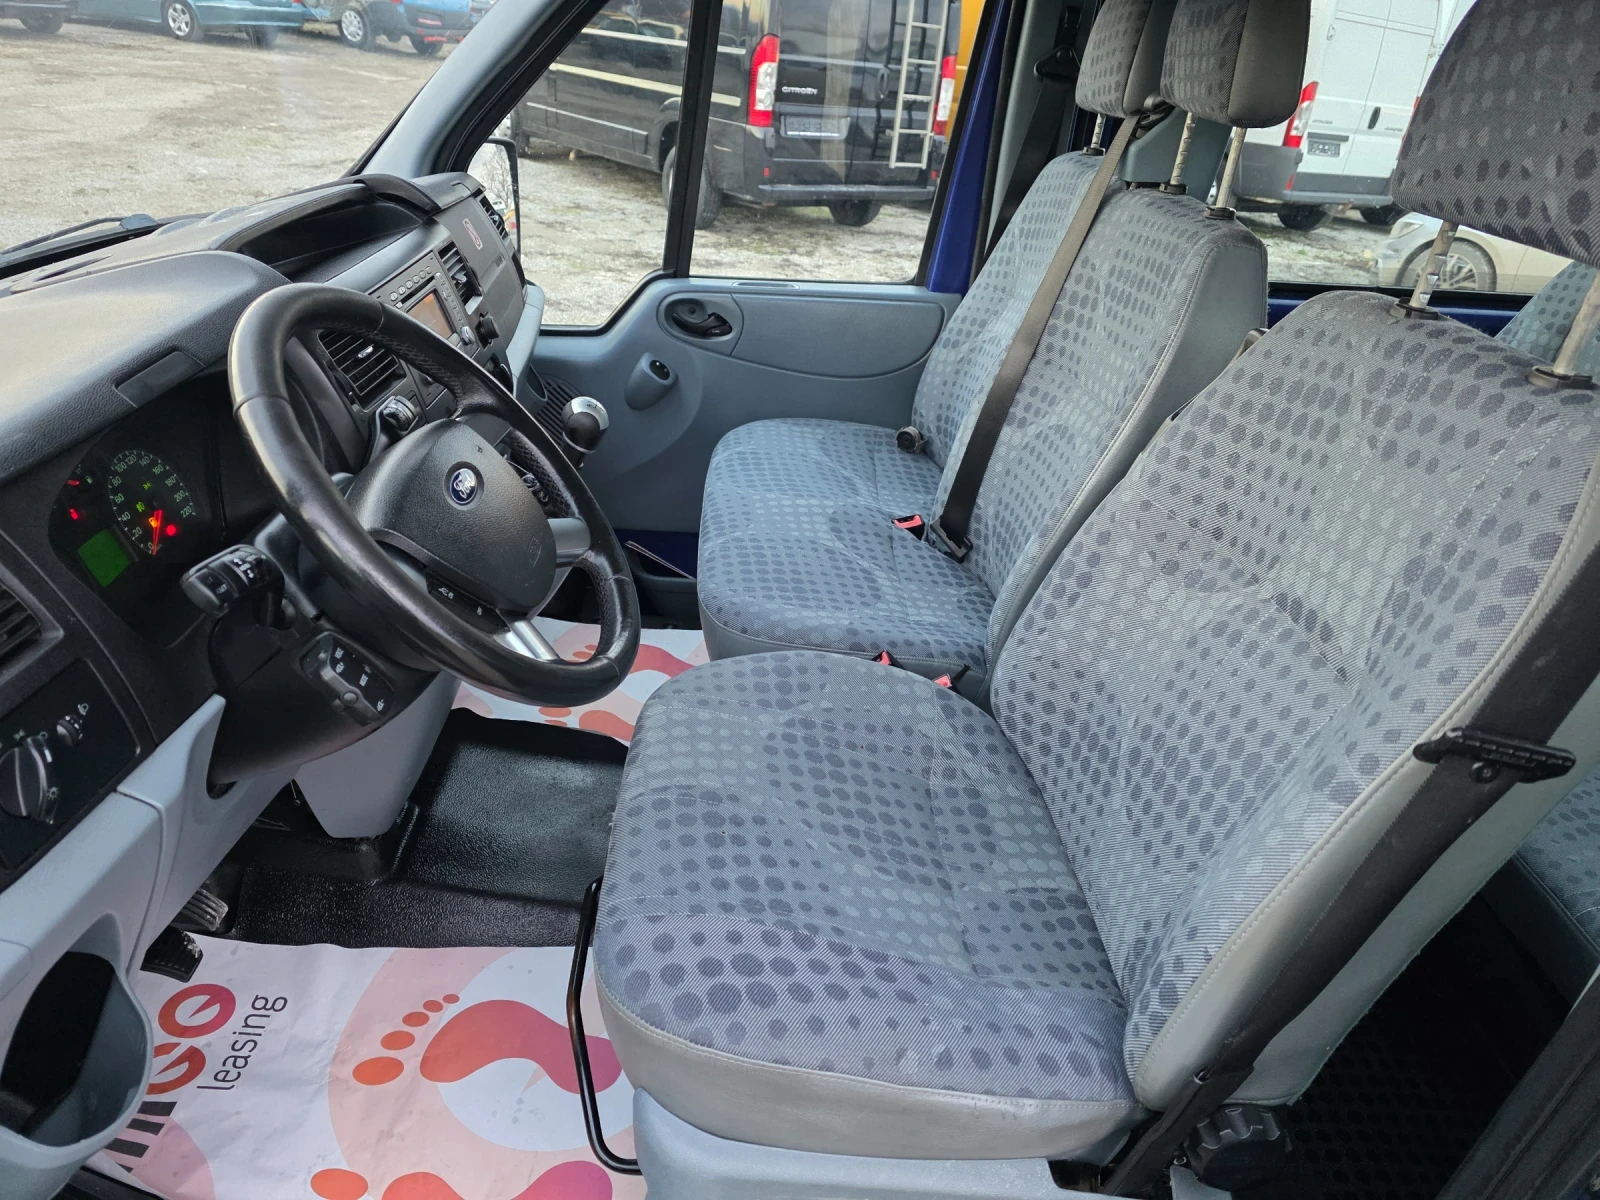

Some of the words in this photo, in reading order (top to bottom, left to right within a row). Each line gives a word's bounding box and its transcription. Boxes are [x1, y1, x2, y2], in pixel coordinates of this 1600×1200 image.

[125, 454, 136, 464] 120
[139, 456, 150, 465] 140
[115, 462, 126, 472] 100
[153, 464, 164, 474] 160
[112, 476, 121, 486] 80
[165, 476, 175, 486] 180
[114, 493, 124, 503] 60
[174, 490, 186, 501] 200
[121, 511, 130, 521] 40
[180, 506, 192, 517] 220
[132, 527, 142, 537] 20
[196, 994, 288, 1091] leasing
